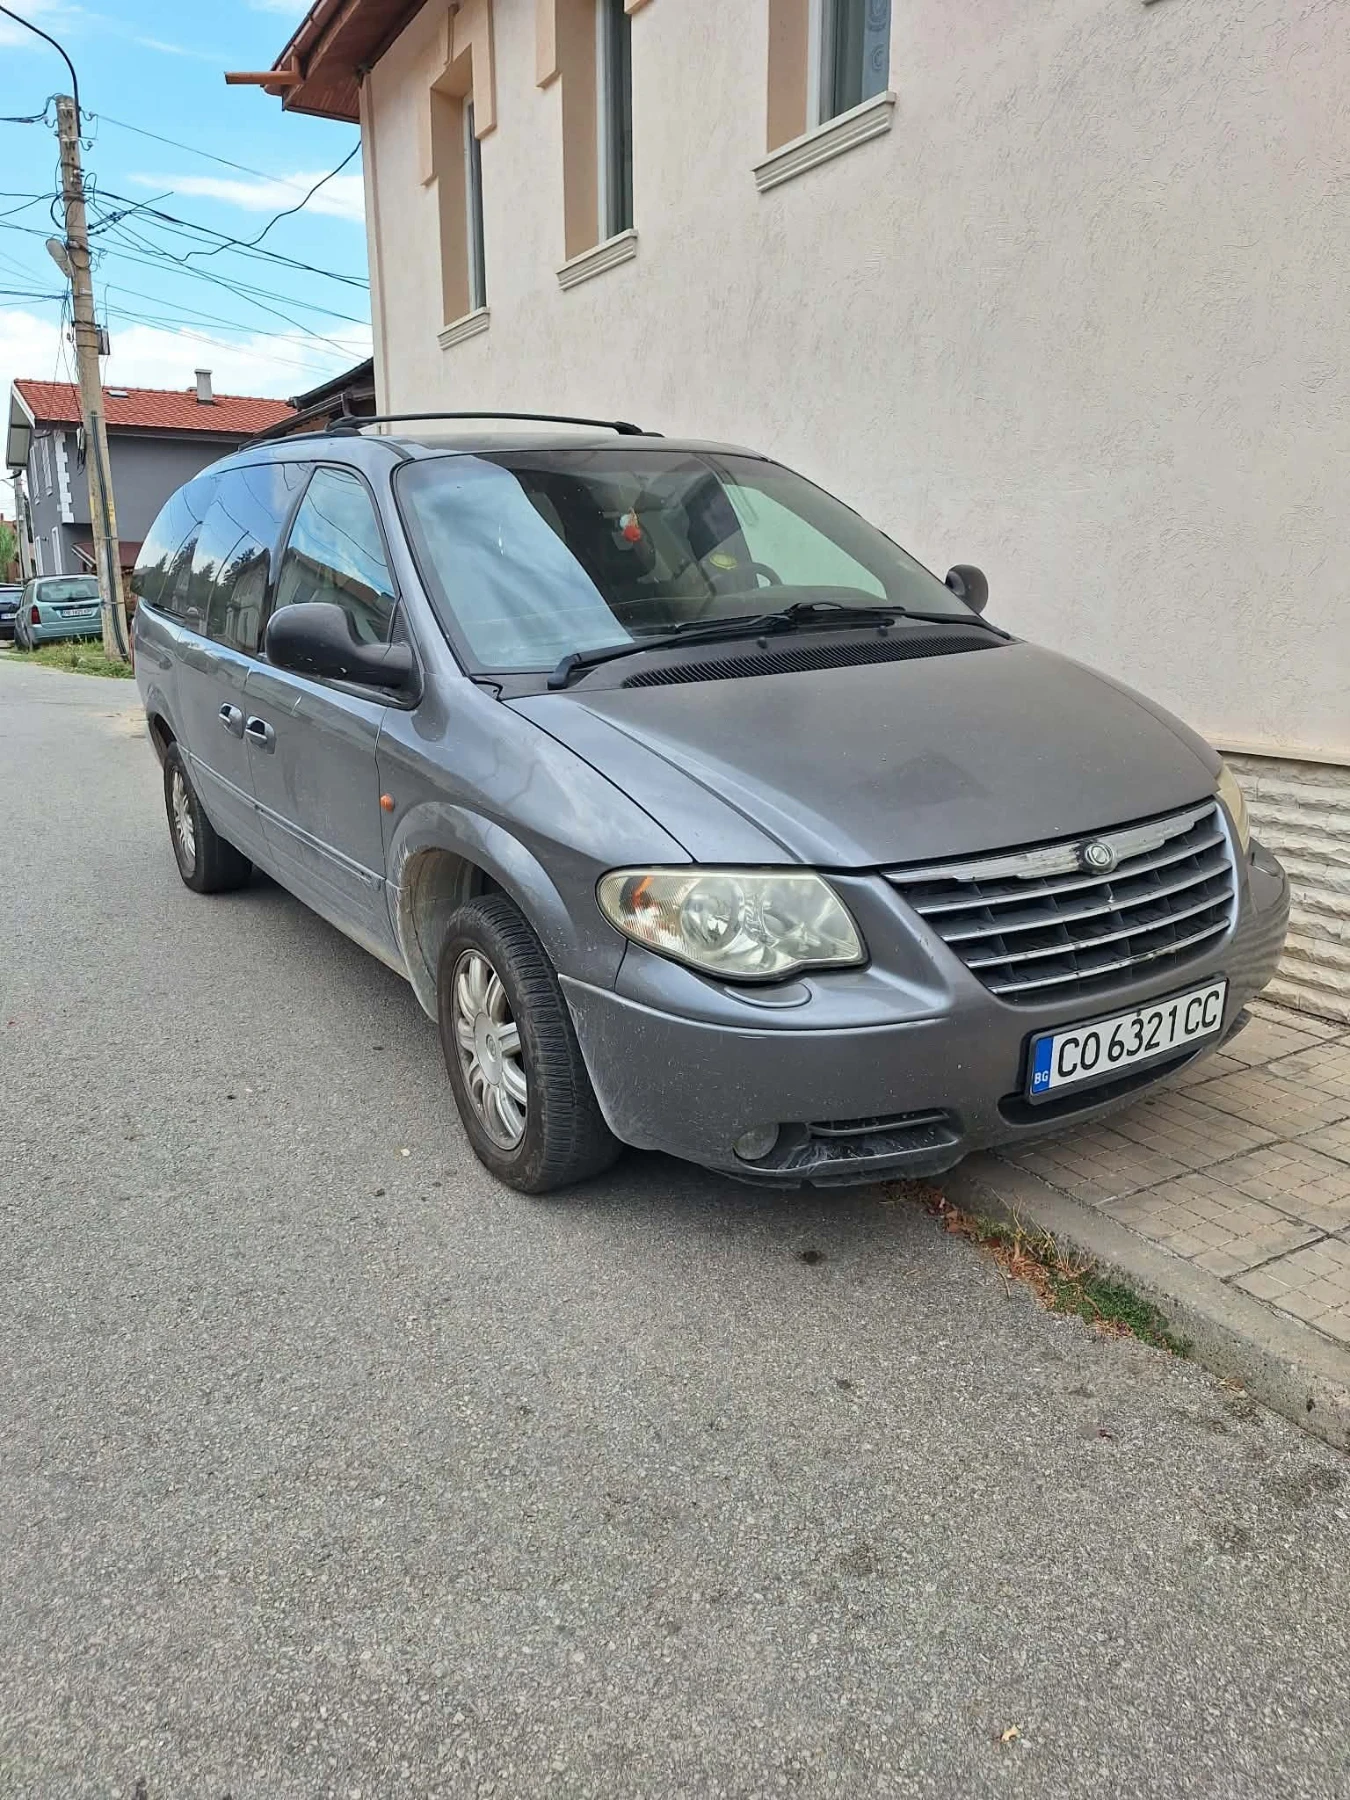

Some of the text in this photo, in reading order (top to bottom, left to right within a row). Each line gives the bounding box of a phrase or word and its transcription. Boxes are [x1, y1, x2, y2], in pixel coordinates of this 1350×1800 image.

[1058, 990, 1220, 1077] CO 6321 CC
[1034, 1070, 1049, 1085] BG
